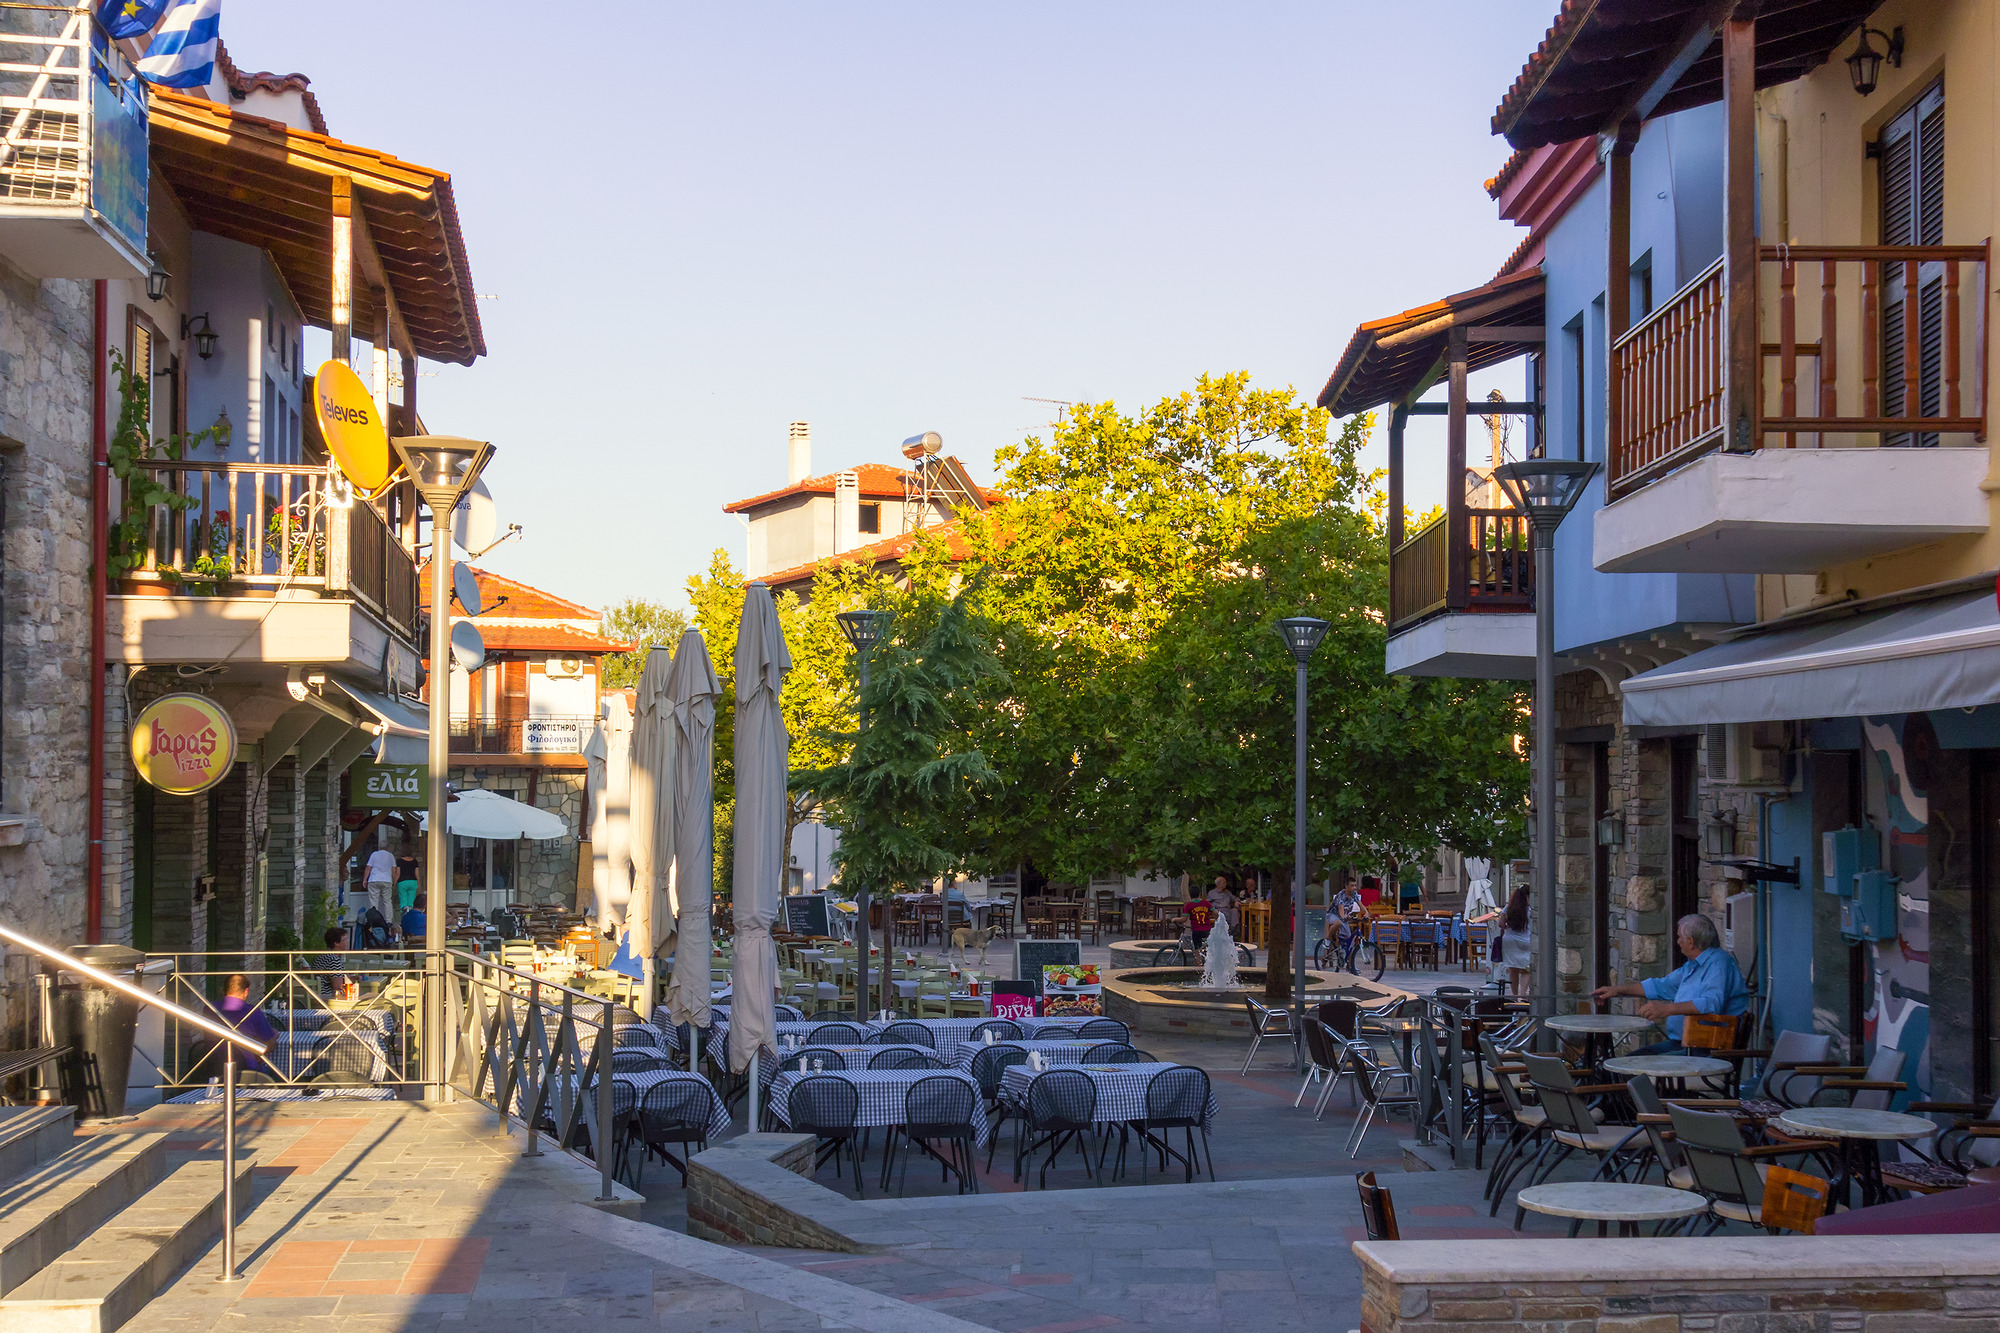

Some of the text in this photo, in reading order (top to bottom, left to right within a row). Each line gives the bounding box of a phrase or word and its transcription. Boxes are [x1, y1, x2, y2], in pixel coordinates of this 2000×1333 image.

[321, 394, 369, 425] Televes
[527, 723, 577, 732] ΦΡΟΝΤΙΣΤΗΡΙΟ
[527, 733, 578, 745] Φιλολογικό
[366, 768, 419, 793] ελιά
[1195, 912, 1206, 925] 17
